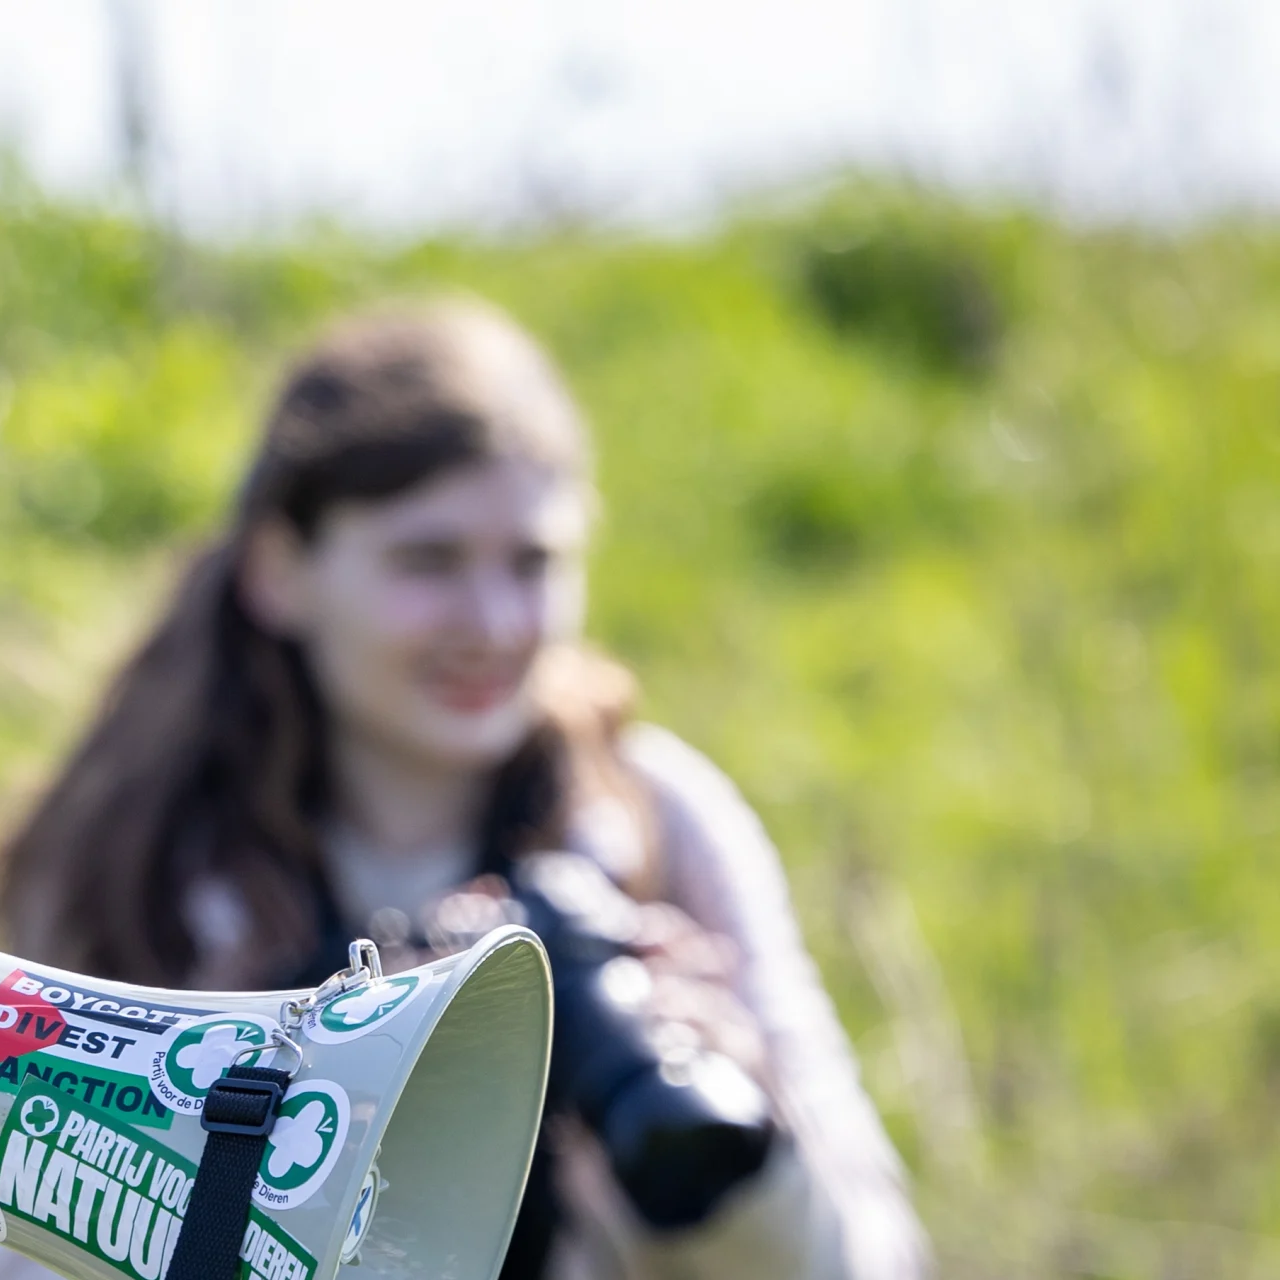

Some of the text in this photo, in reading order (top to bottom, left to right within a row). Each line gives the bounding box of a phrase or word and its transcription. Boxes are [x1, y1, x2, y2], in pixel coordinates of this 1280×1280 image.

[11, 976, 200, 1025] BOYCOTT
[151, 1051, 191, 1109] Partij voor de
[57, 1110, 153, 1188] PARTIJ
[258, 1184, 289, 1203] Dieren
